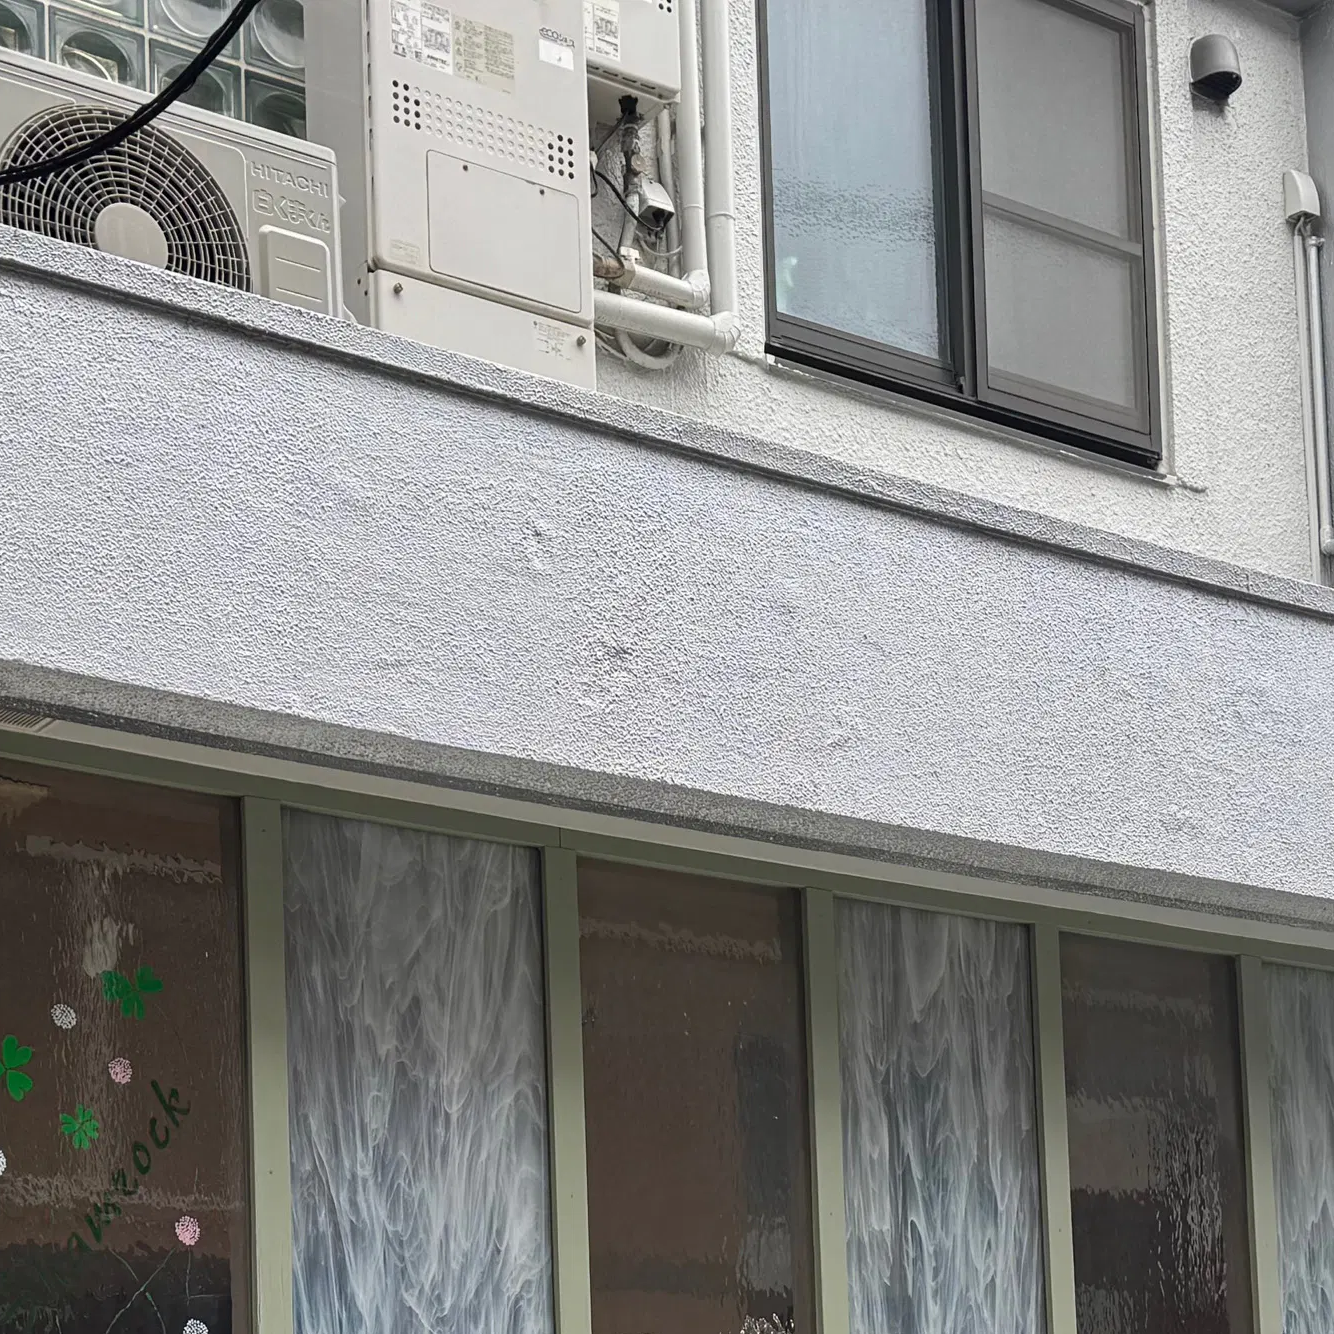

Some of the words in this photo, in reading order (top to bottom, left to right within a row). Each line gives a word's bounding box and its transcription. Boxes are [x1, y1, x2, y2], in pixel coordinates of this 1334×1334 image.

[250, 161, 329, 198] HITACHI
[252, 189, 331, 233] 白くまくん
